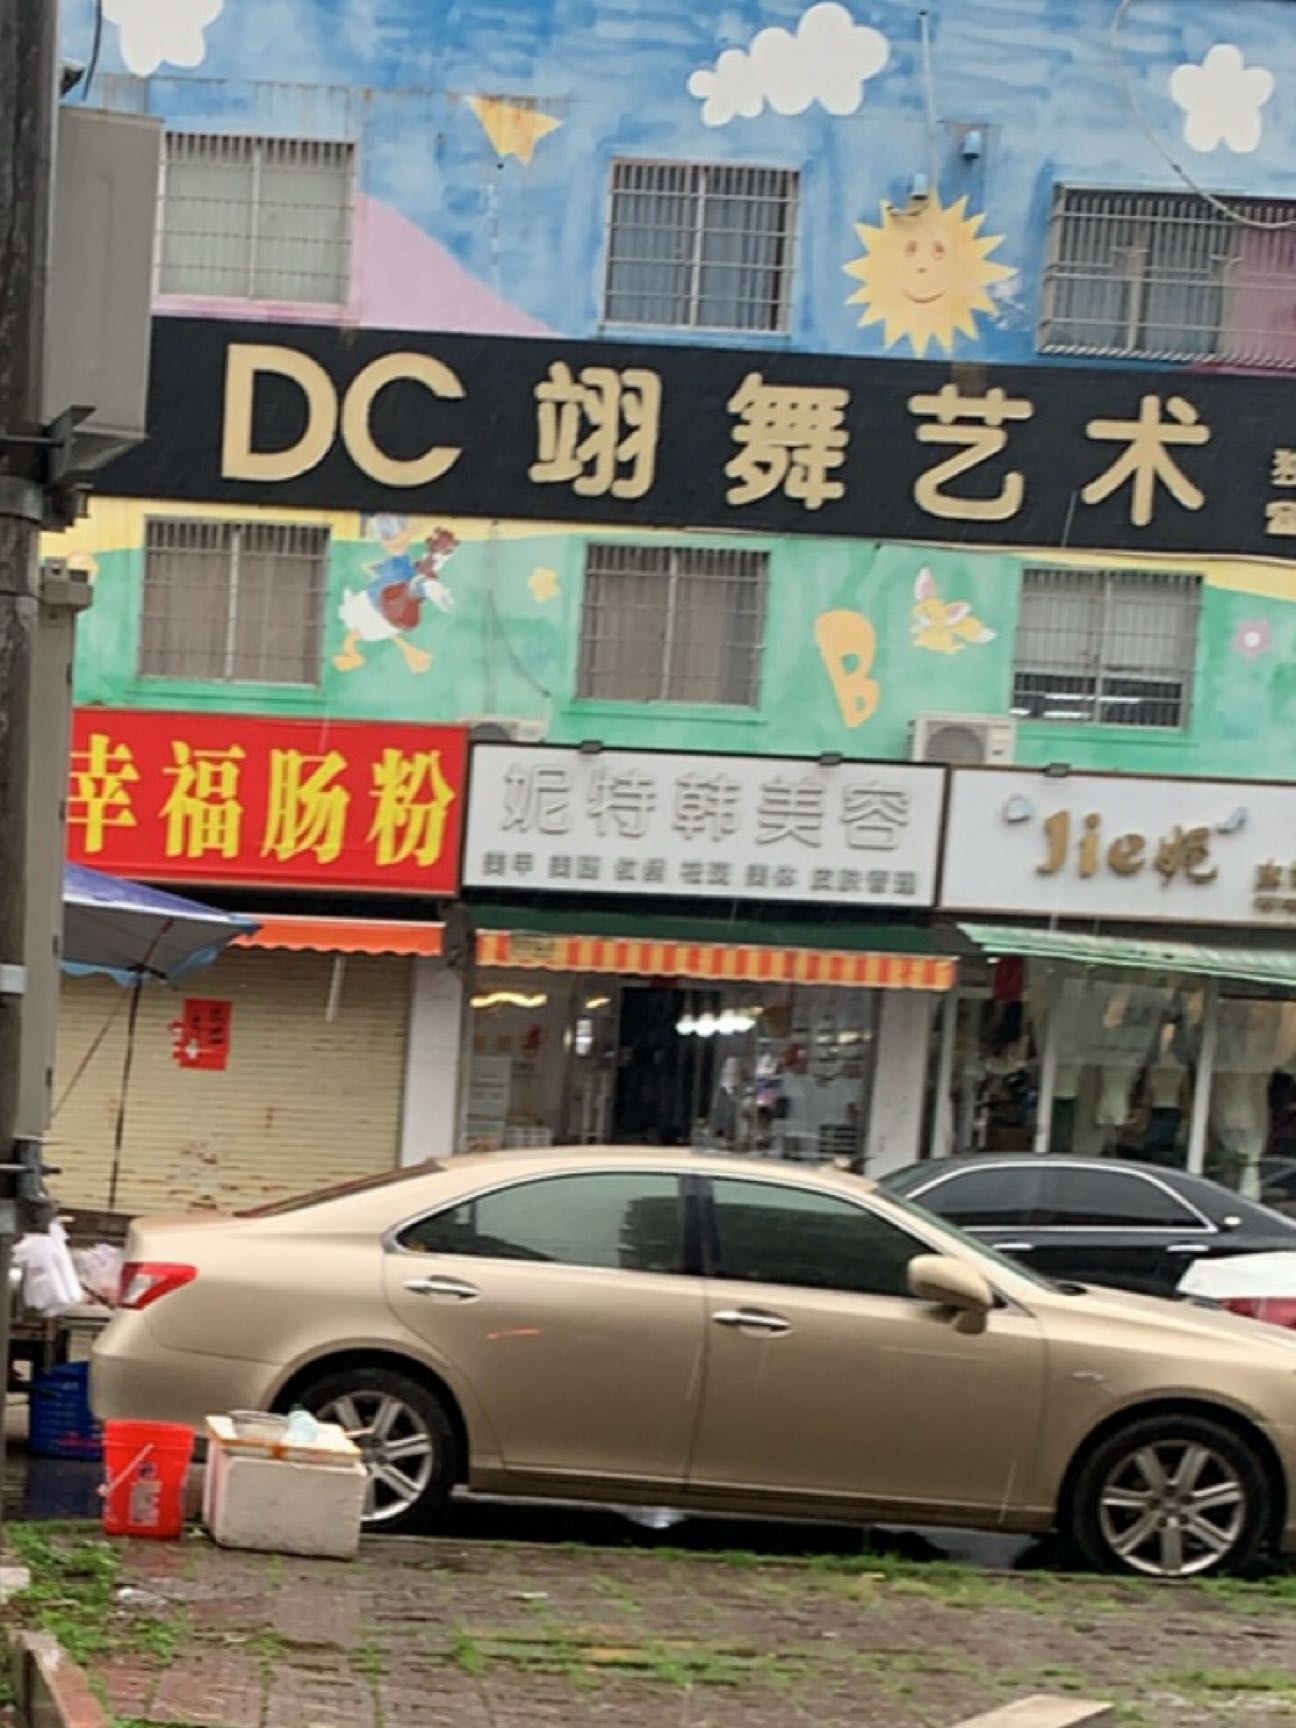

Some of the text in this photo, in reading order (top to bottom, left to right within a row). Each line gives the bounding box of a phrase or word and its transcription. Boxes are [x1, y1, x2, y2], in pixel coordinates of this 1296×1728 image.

[221, 343, 1211, 527] DC 翊舞艺术
[67, 733, 456, 868] 幸福肠粉
[502, 762, 911, 851] 妮特韩美容
